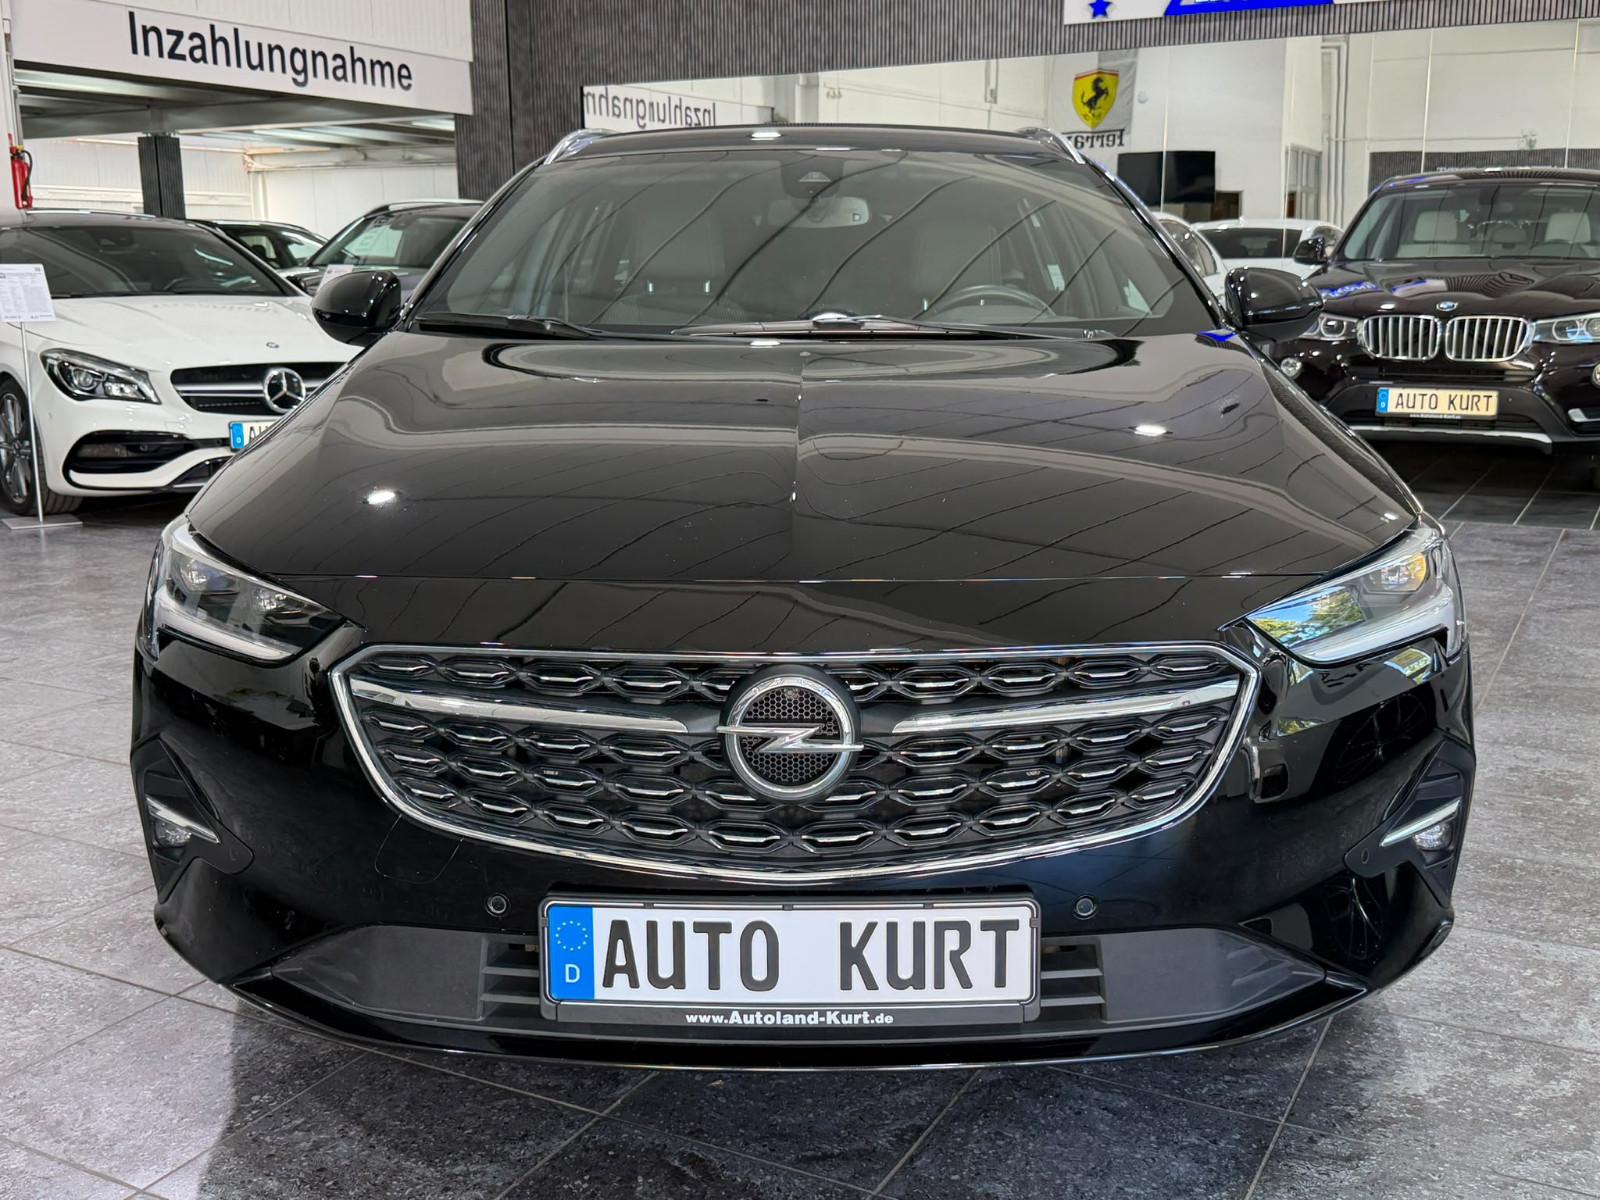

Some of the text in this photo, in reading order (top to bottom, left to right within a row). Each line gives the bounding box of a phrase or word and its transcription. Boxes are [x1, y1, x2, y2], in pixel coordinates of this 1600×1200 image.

[128, 11, 413, 90] Inzahlungnahme
[1395, 393, 1493, 412] AUTO KURT
[602, 918, 1020, 992] AUTO KURT
[564, 964, 581, 984] D
[685, 1010, 894, 1025] www.Autoland-Kurt.de
